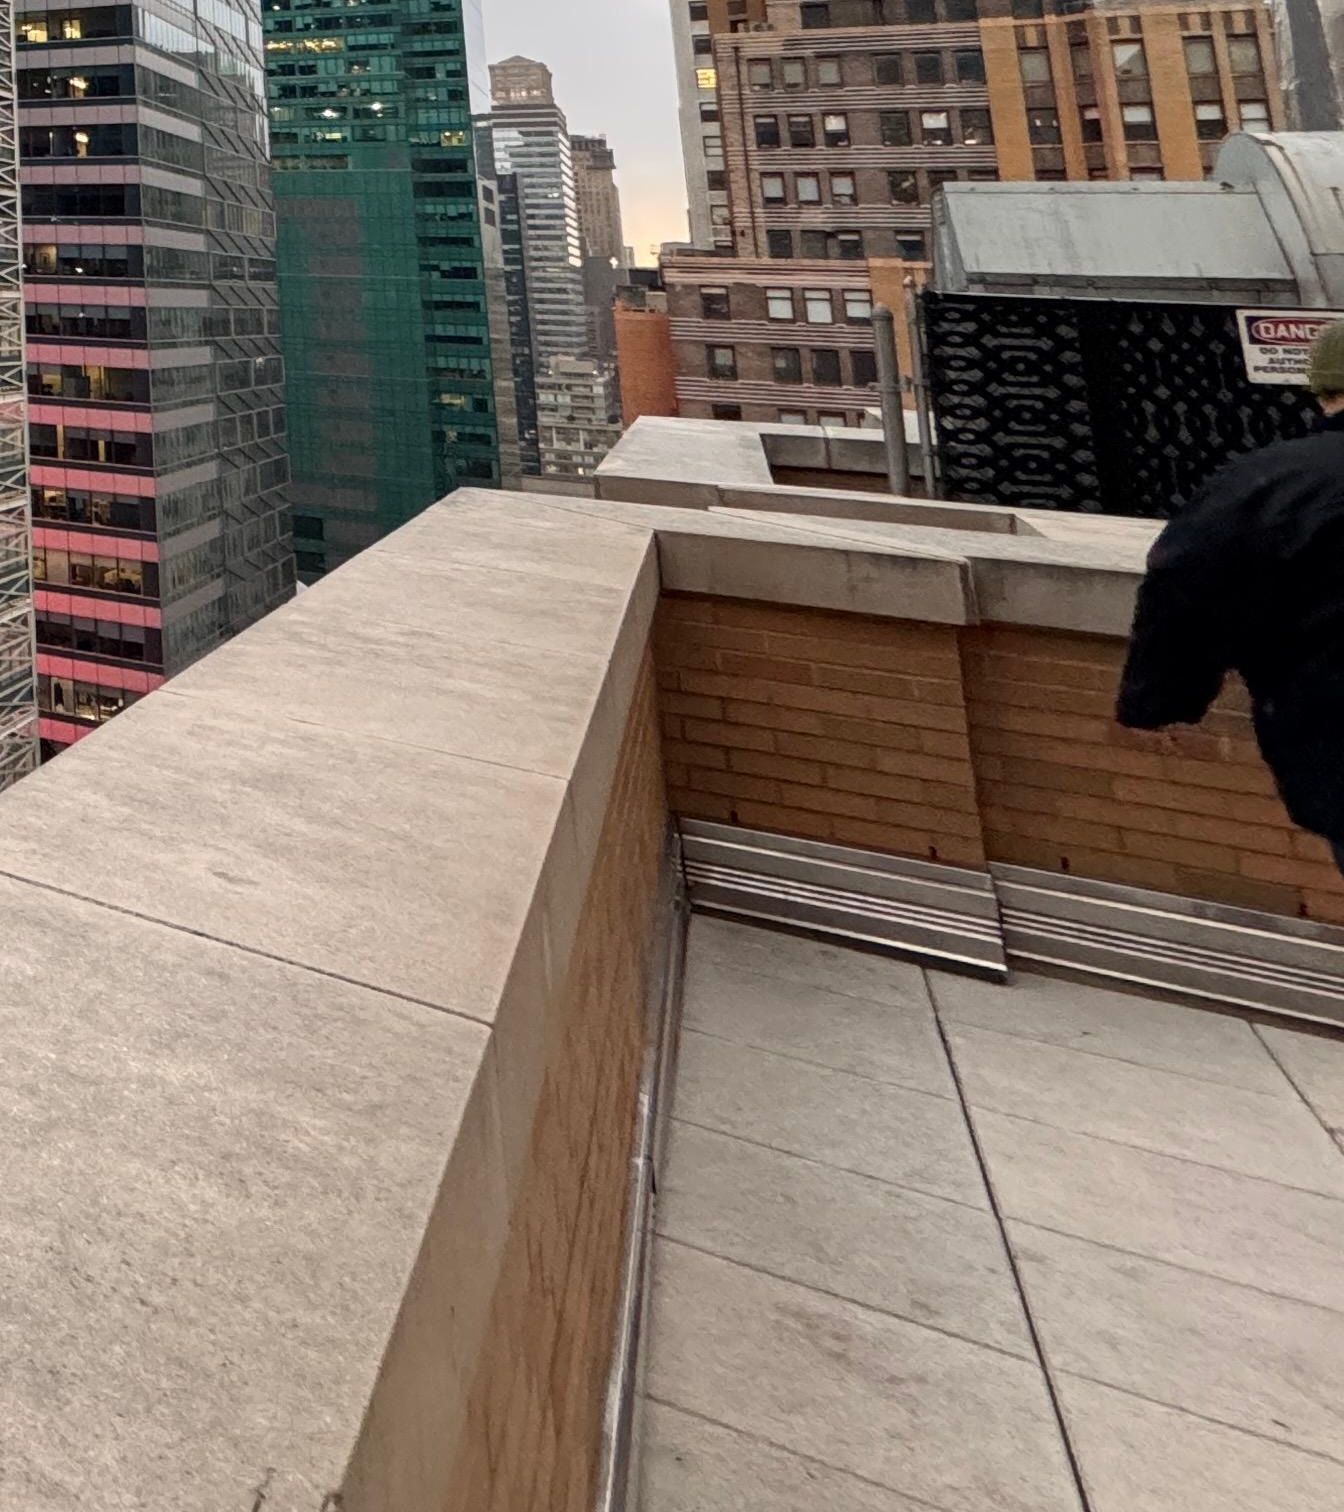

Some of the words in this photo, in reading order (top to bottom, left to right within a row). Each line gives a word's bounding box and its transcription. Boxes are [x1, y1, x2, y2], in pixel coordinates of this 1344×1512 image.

[1258, 322, 1320, 340] DANG
[1259, 347, 1279, 356] DO
[1282, 348, 1310, 356] NOT
[1253, 366, 1308, 374] PERSON
